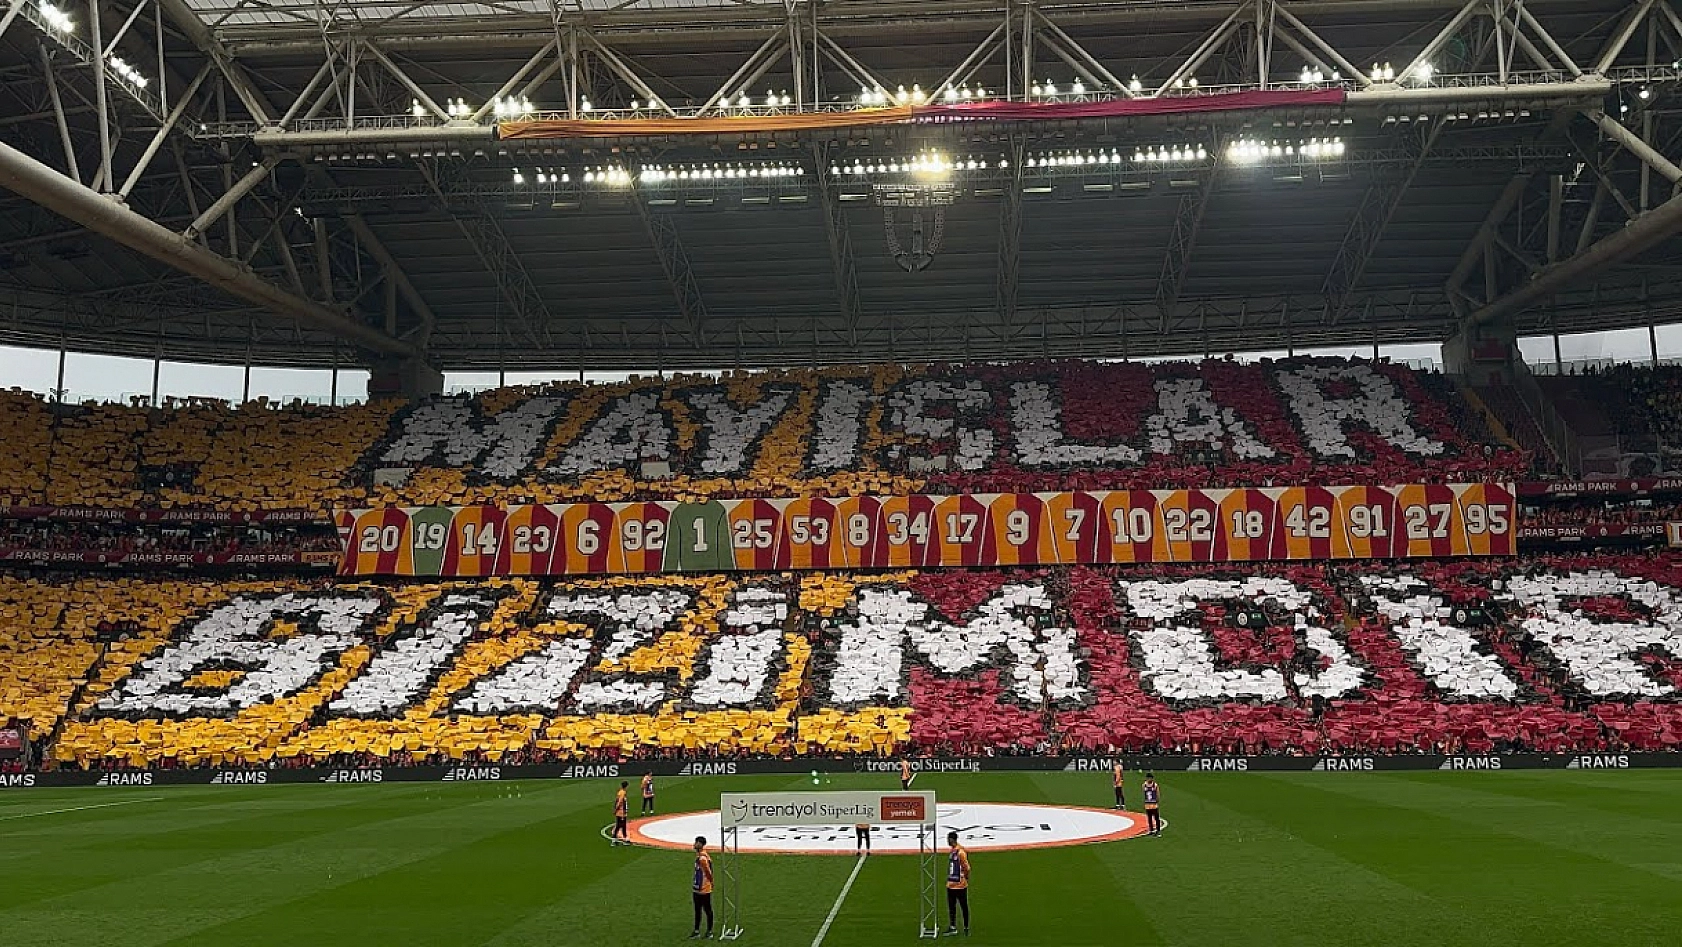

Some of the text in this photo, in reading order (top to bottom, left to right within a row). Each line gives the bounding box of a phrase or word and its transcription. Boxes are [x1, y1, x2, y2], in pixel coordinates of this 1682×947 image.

[1554, 482, 1617, 492] RAMS PARK
[59, 509, 126, 519] RAMS PARK
[170, 511, 231, 520] RAMS PARK
[270, 512, 300, 520] RAMS
[360, 526, 399, 552] 20
[415, 523, 446, 549] 19
[462, 522, 497, 555] 14
[514, 526, 550, 553] 23
[577, 519, 599, 555] 6
[623, 519, 664, 550] 92
[692, 518, 708, 552] 1
[734, 519, 772, 549] 25
[792, 515, 828, 544] 53
[849, 514, 870, 546] 8
[888, 511, 928, 545] 34
[946, 514, 978, 544] 17
[1006, 510, 1030, 546] 9
[1065, 509, 1085, 540] 7
[1112, 508, 1152, 544] 10
[1166, 509, 1211, 541] 22
[1232, 511, 1263, 538] 18
[1286, 504, 1330, 538] 42
[1350, 504, 1387, 538] 91
[1406, 504, 1450, 539] 27
[1467, 504, 1508, 534] 95
[1525, 527, 1586, 537] RAMS PARK
[1632, 526, 1664, 534] RAMS
[15, 551, 84, 561] RAMS PARK
[130, 553, 194, 563] RAMS PARK
[235, 554, 295, 562] RAMS PARK
[925, 758, 980, 772] SüperLig
[1078, 758, 1123, 771] RAM
[1201, 758, 1247, 771] RAMS
[1327, 758, 1374, 770] RAMS
[1453, 757, 1501, 770] RAMS
[1582, 755, 1629, 769] RAMS
[456, 768, 500, 780] RAMS
[575, 765, 619, 778] RAMS
[692, 763, 736, 775] RAMS
[110, 773, 152, 785] RAMS
[224, 772, 267, 784] RAMS
[340, 770, 382, 782] RAMS
[752, 802, 874, 819] trendyol SüperLig
